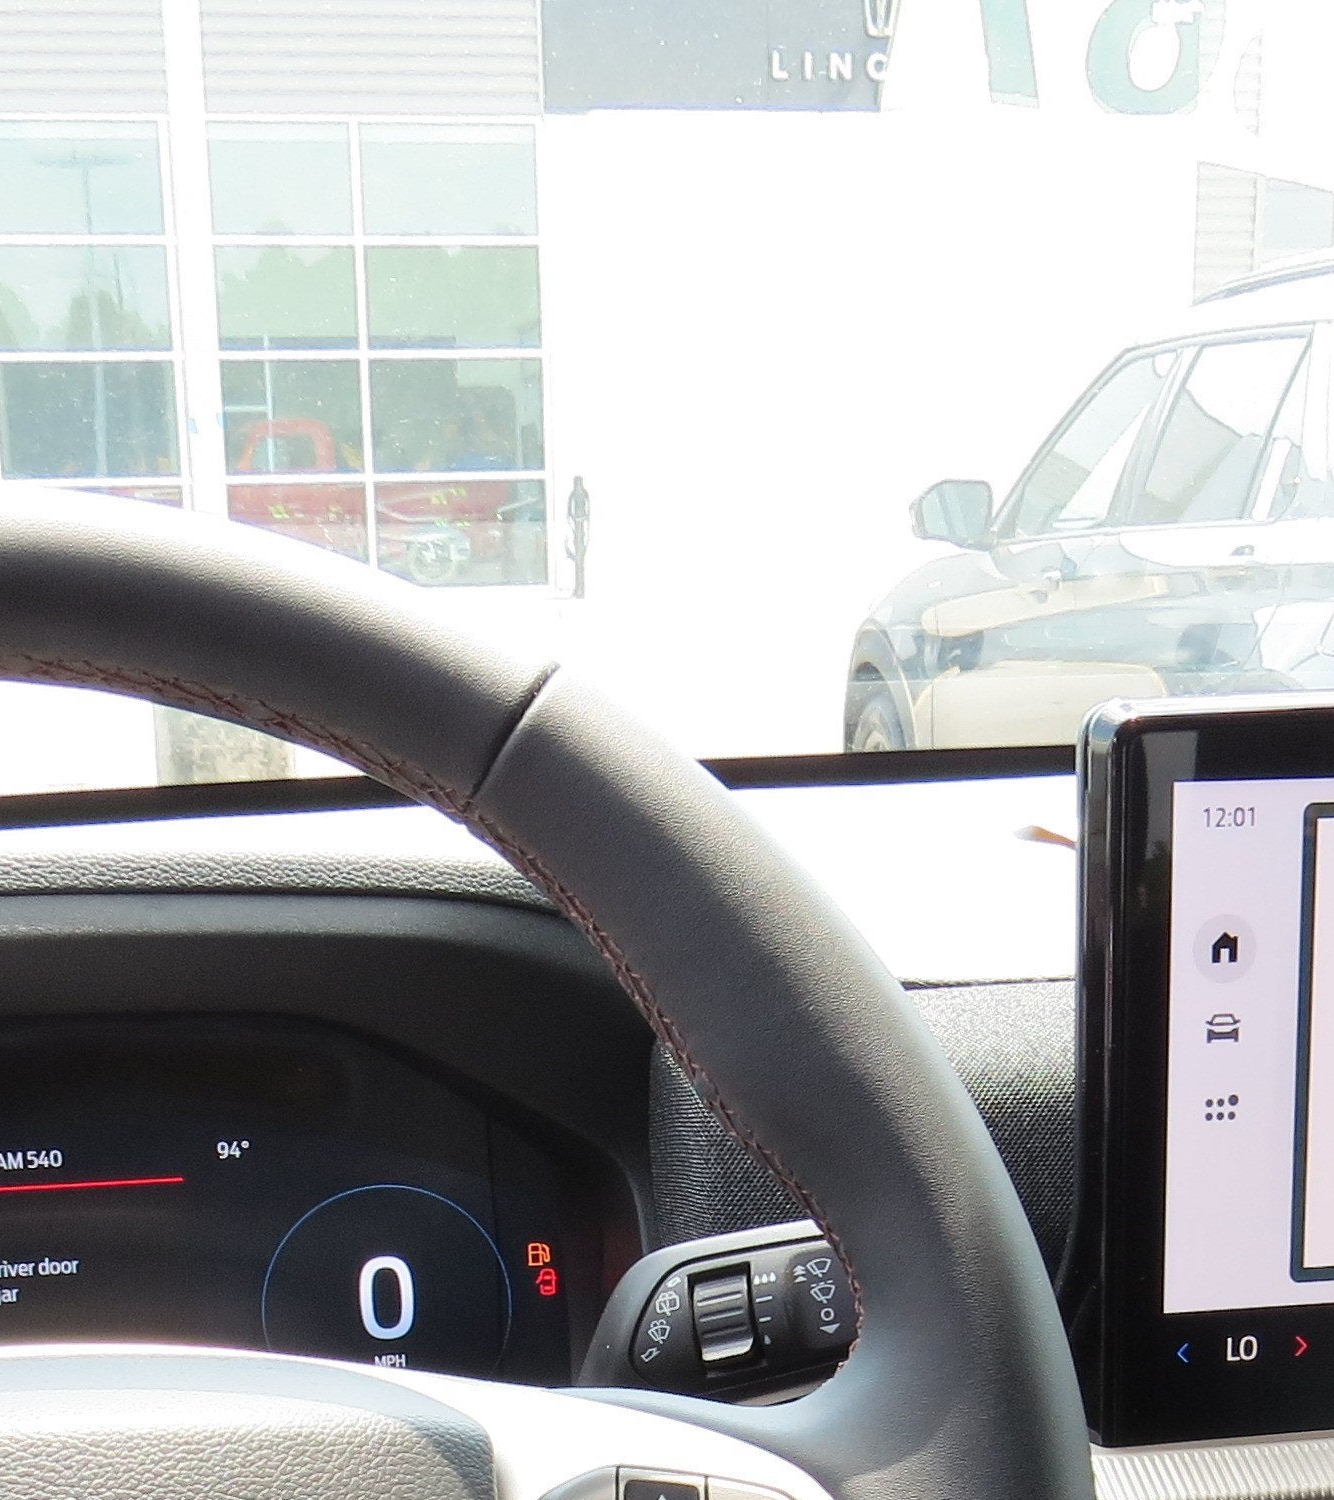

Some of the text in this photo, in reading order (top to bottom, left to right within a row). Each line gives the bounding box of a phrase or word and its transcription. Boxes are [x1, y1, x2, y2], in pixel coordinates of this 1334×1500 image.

[1202, 806, 1257, 829] 12:01
[27, 1149, 63, 1170] 540
[216, 1140, 250, 1161] 94°
[38, 1257, 79, 1276] door
[358, 1255, 415, 1340] 0
[1225, 1335, 1259, 1362] LO
[373, 1354, 407, 1368] MPH
